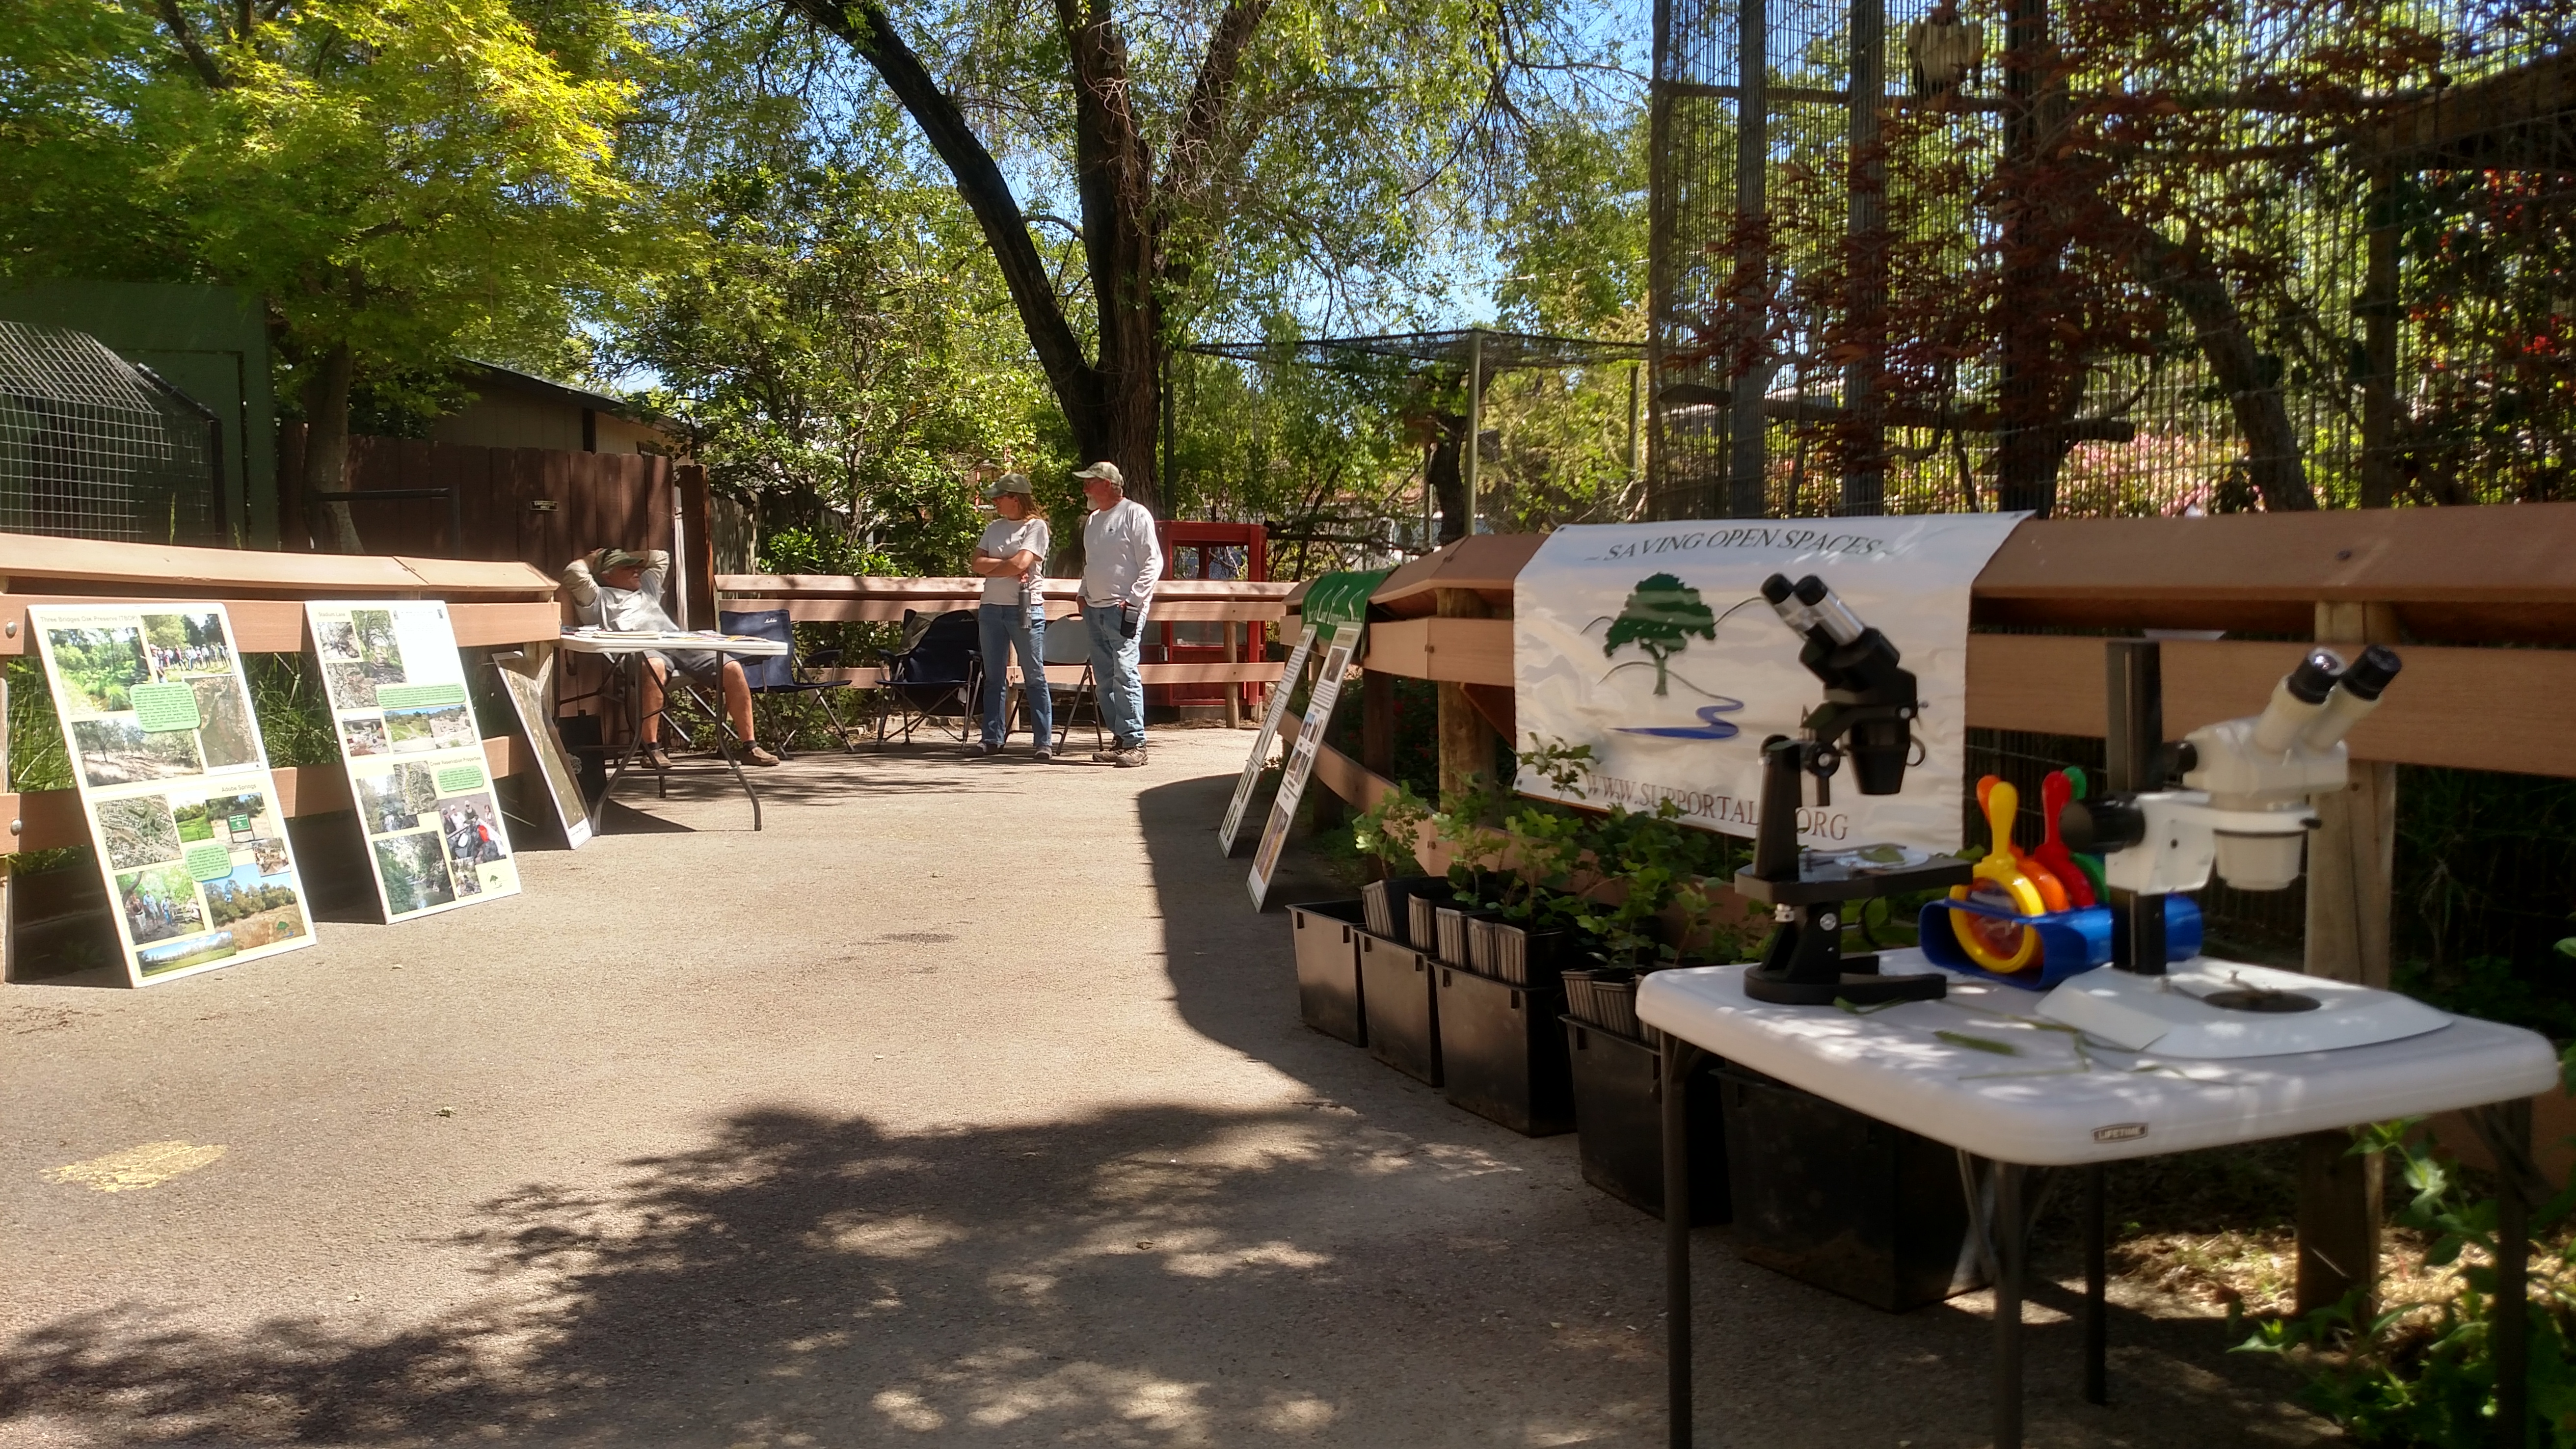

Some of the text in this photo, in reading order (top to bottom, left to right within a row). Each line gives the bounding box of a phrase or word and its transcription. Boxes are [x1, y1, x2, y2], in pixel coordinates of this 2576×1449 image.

[1603, 528, 1883, 561] SAVING OPEN SPACES
